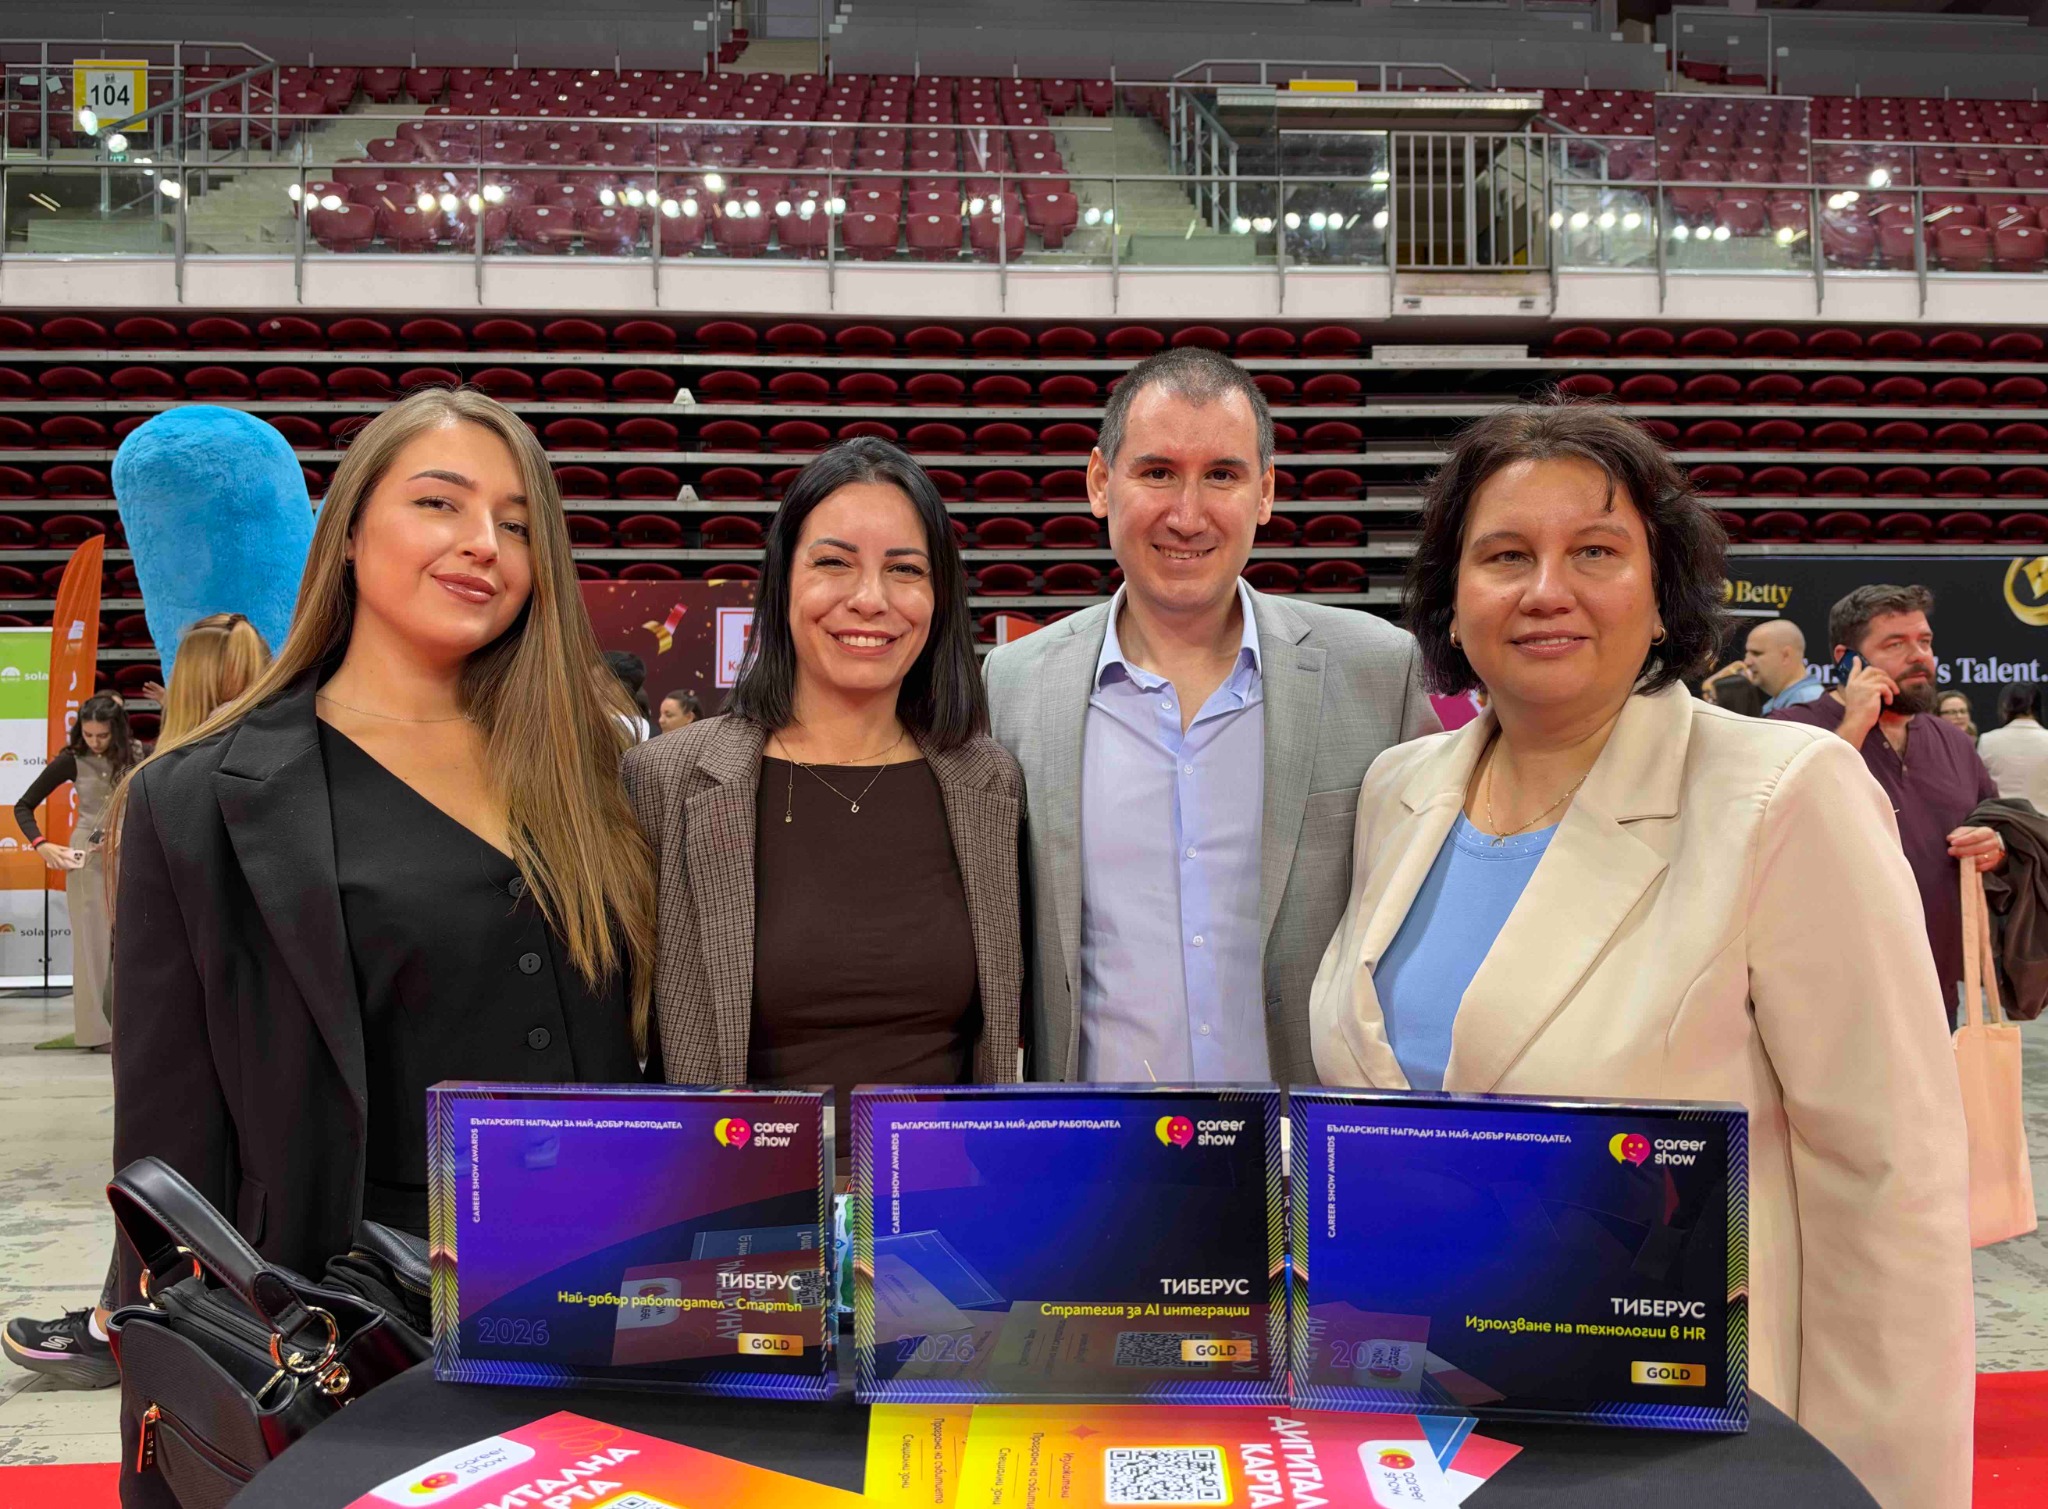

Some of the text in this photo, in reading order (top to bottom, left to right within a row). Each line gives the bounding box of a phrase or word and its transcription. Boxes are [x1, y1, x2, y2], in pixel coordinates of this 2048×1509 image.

[91, 84, 130, 106] 104
[1736, 580, 1792, 609] Betty
[24, 670, 49, 681] sola
[1955, 656, 2048, 684] Talent.
[23, 756, 48, 766] sola
[20, 927, 72, 938] solapro
[470, 1118, 683, 1130] БЪЛГАРСКИТЕ НАГРАДИ ЗА НАЙ-ДОБЪР РАБОТОДАТЕЛ
[753, 1122, 800, 1133] career
[891, 1119, 1121, 1130] БЪЛГАРСКИТЕ НАГРАДИ ЗА НАЙ-ДОБЪР РАБОТОДАТЕЛ
[1197, 1120, 1246, 1131] career
[1327, 1124, 1572, 1144] БЪЛГАРСКИТЕ НАГРАДИ ЗА НАЙ-ДОБЪР РАБОТОДАТЕЛ
[754, 1133, 790, 1147] show
[1198, 1131, 1236, 1146] show
[1654, 1138, 1707, 1152] career
[1655, 1150, 1696, 1166] show
[471, 1128, 481, 1223] CAREER SHOW AWARDS
[891, 1132, 900, 1234] CAREER SHOW AWARDS
[1327, 1135, 1336, 1238] CAREER SHOW AWARDS
[719, 1273, 801, 1291] ТИБЕРУС
[1160, 1278, 1250, 1296] ТИБЕРУС
[557, 1290, 629, 1308] Най-добър
[631, 1293, 725, 1312] работодател
[736, 1298, 802, 1314] Стартъп
[1040, 1303, 1250, 1319] Стратегия за AI интеграции
[1611, 1297, 1706, 1319] ТИБЕРУС
[479, 1317, 550, 1346] 2026
[1466, 1315, 1706, 1340] Използване на технологии в HR
[752, 1338, 790, 1350] GOLD
[897, 1334, 975, 1363] 2026
[1196, 1344, 1237, 1357] GOLD
[1330, 1340, 1413, 1372] 2026
[1646, 1367, 1691, 1381] GOLD
[454, 1447, 506, 1470] career
[466, 1455, 508, 1474] show
[1267, 1416, 1329, 1509] ДИГИТАЛ
[1240, 1443, 1285, 1509] КАРТА
[1384, 1472, 1404, 1497] show
[541, 1479, 623, 1509] РТА
[1026, 1478, 1041, 1509] събити
[1402, 1471, 1427, 1503] career
